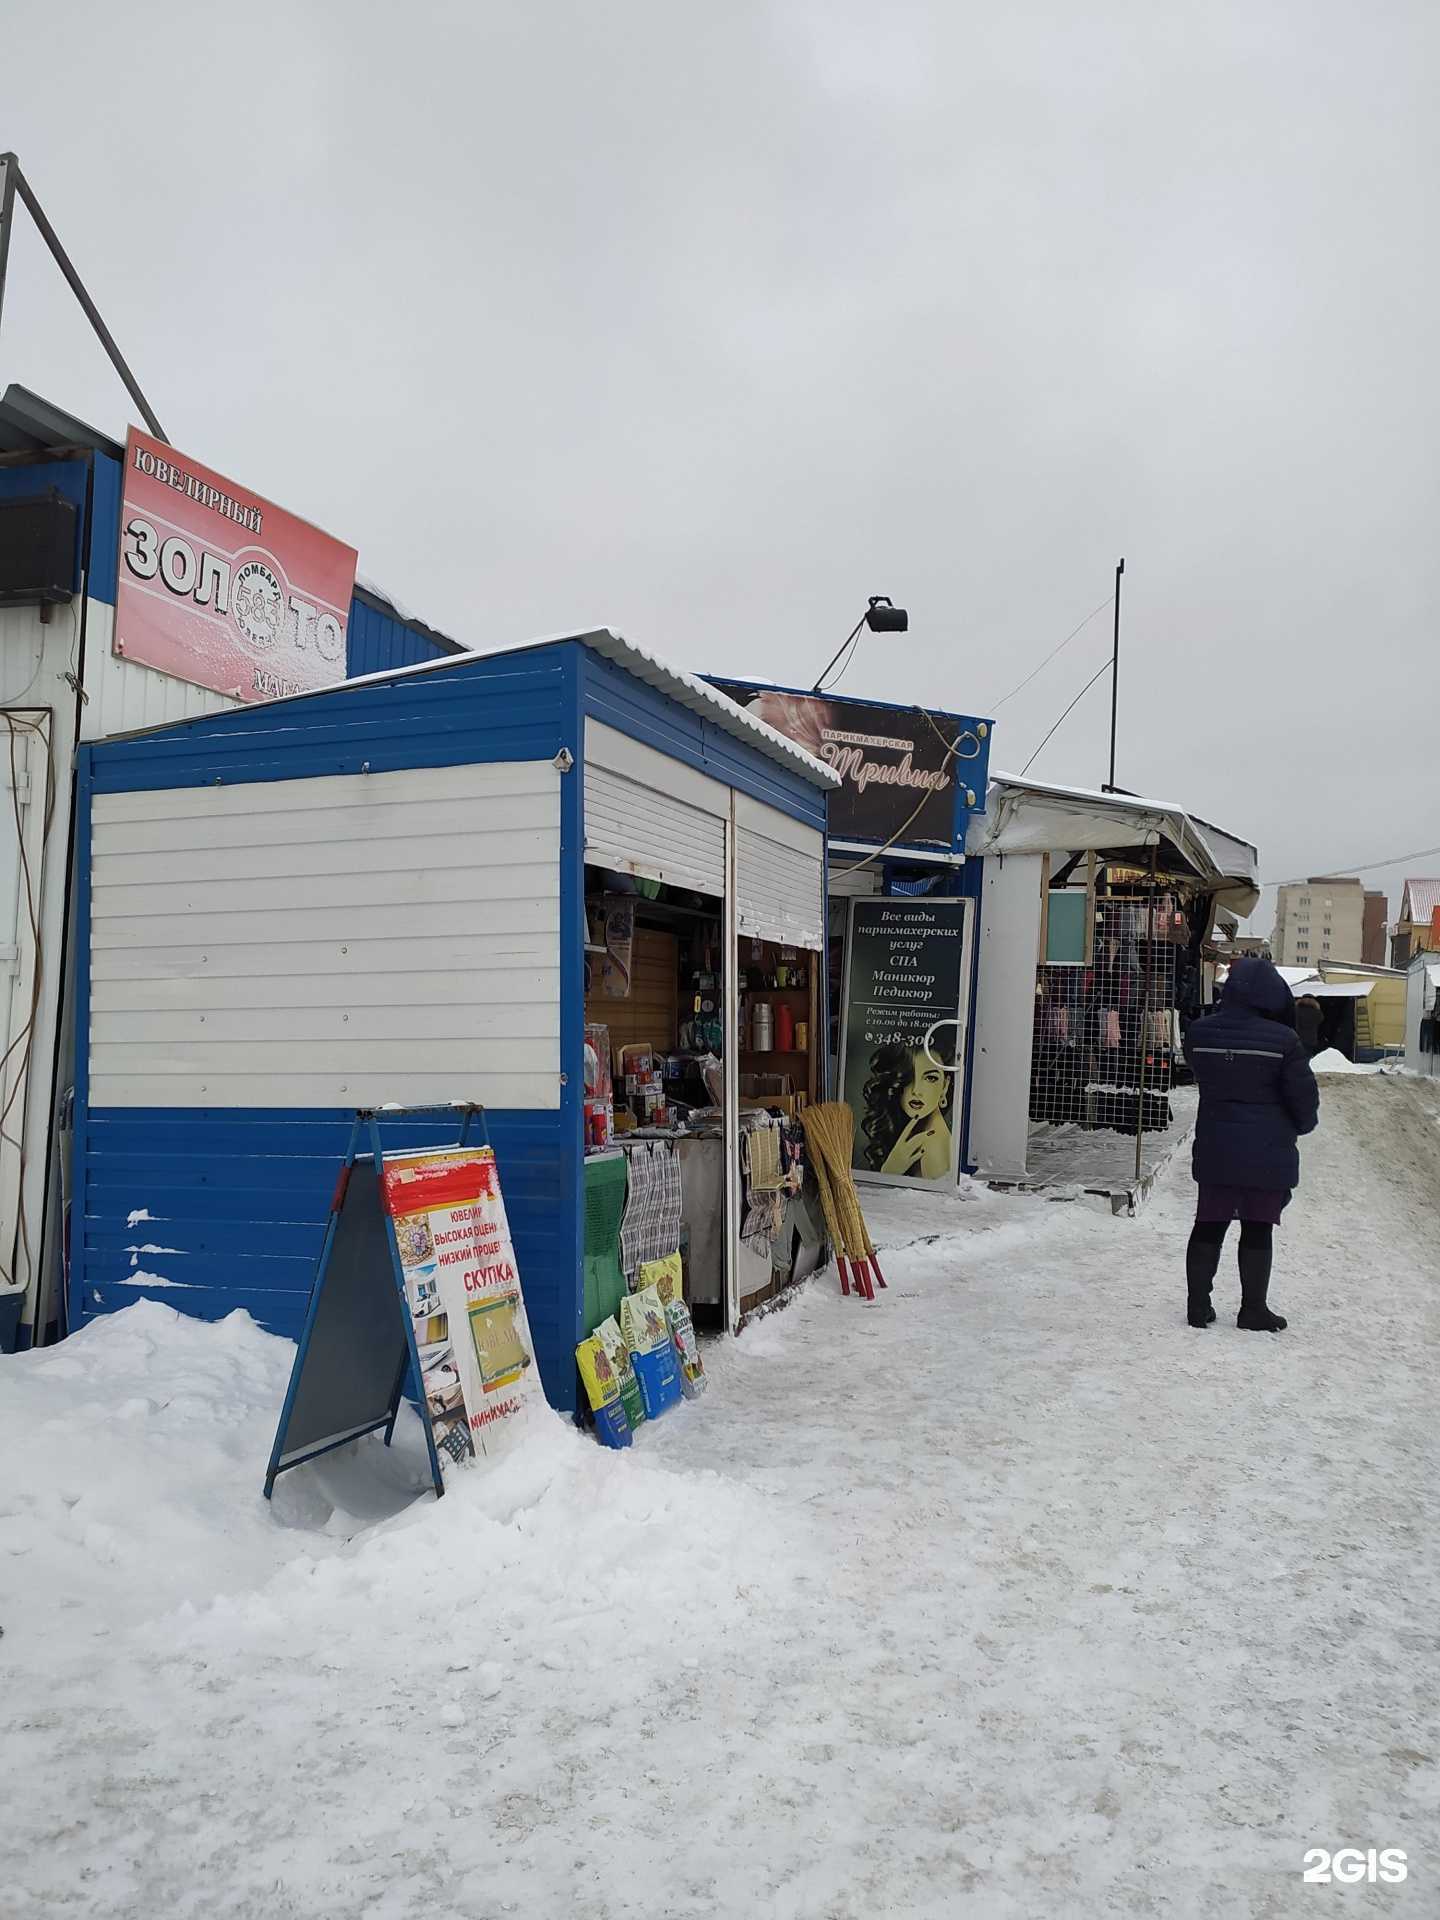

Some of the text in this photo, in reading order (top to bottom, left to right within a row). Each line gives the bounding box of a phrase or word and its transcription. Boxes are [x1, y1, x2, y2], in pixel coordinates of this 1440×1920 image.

[133, 446, 264, 536] ЮВЕЛИРНЫЙ
[238, 563, 281, 603] ЛОМБАРД
[822, 729, 914, 751] ПАРИКМАХЕРСКАЯ
[881, 911, 936, 922] Все виды
[858, 926, 960, 938] парикмахерских
[889, 940, 924, 951] услуг
[889, 955, 918, 967] СПА
[872, 970, 936, 986] Маникюр
[873, 986, 933, 1001] Педикюр
[866, 1007, 940, 1019] Режим работы:
[897, 1019, 908, 1028] до
[434, 1226, 473, 1247] ВЫСОКАЯ
[438, 1241, 502, 1267] НИЗКИЙ ПРОЦЕ
[463, 1263, 514, 1292] СКУПКА
